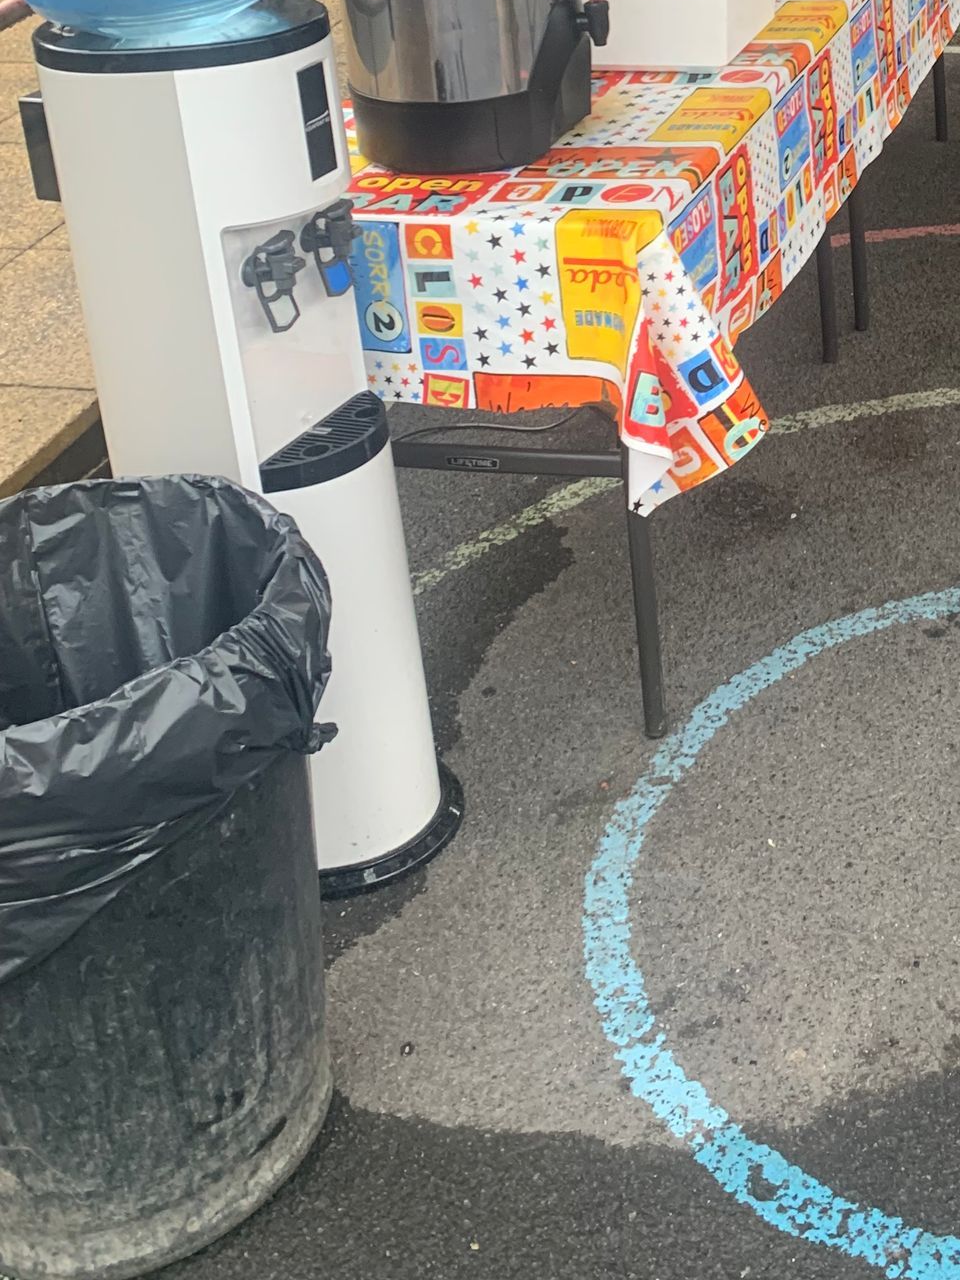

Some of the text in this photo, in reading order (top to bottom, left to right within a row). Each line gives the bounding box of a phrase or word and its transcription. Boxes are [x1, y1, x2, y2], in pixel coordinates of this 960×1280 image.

[356, 176, 483, 193] open
[546, 160, 694, 179] OPEN
[674, 195, 711, 254] CLOSED
[719, 166, 742, 299] BAR
[736, 157, 753, 274] open
[373, 311, 395, 333] 2
